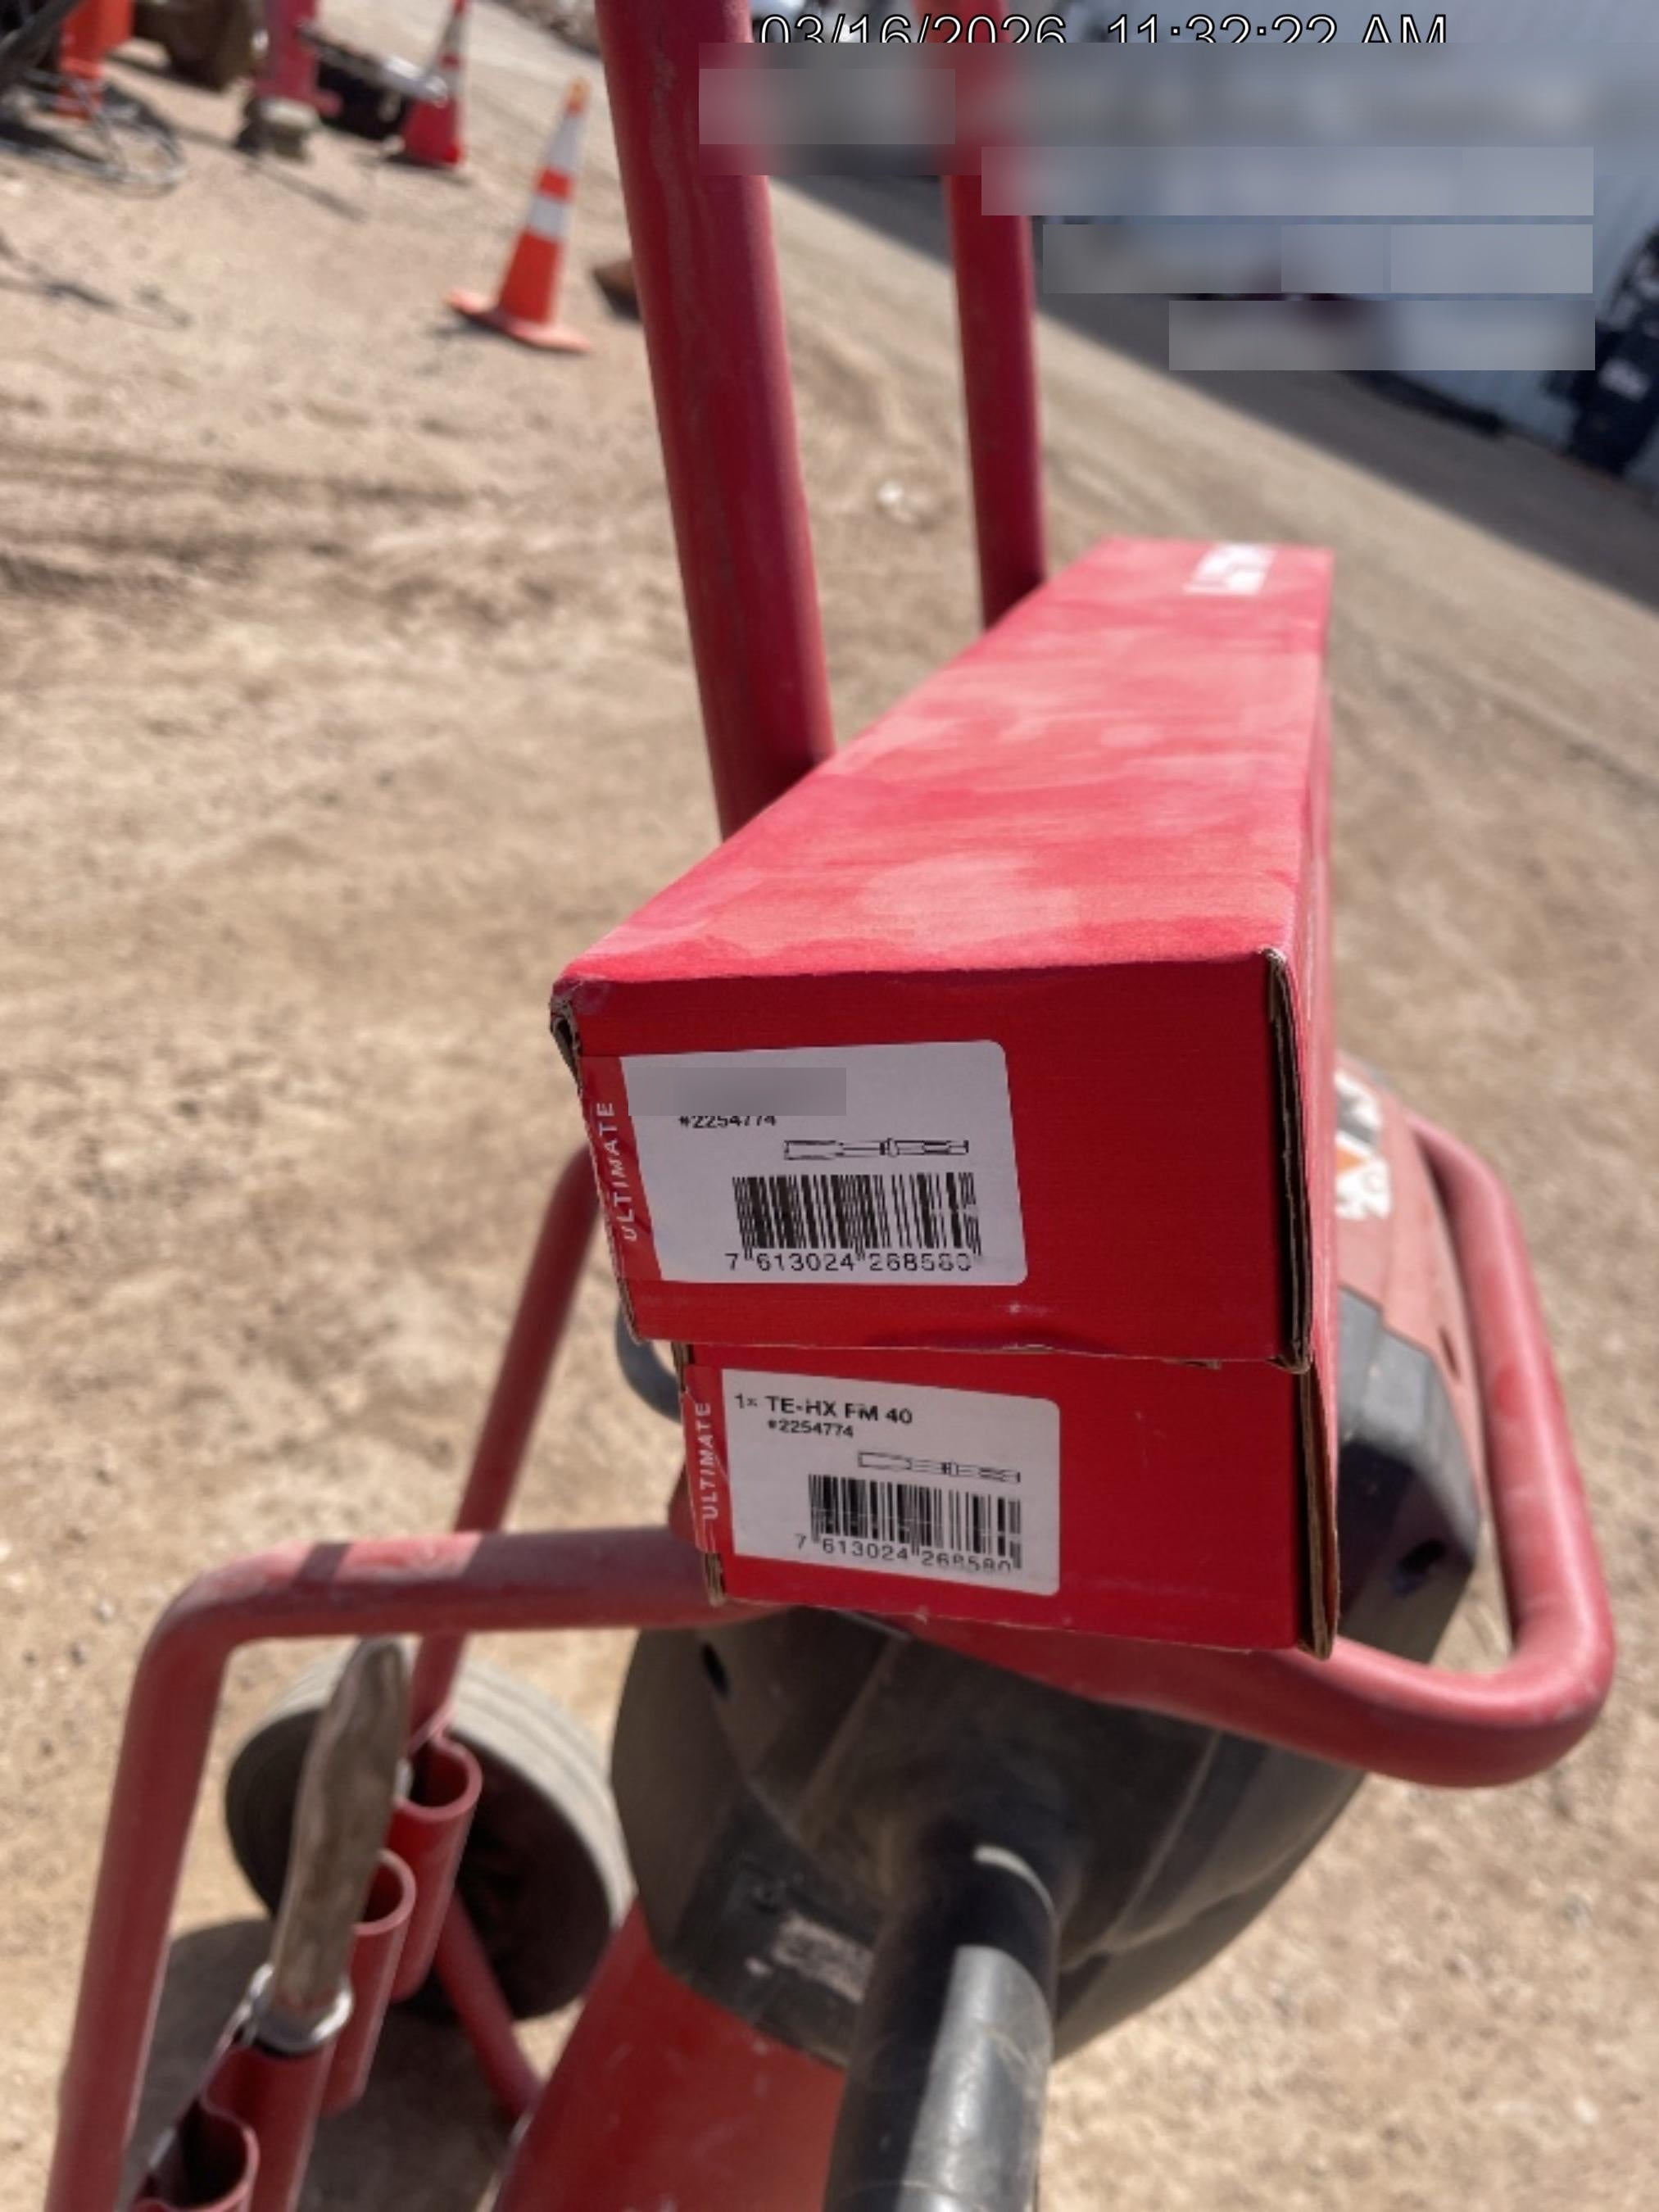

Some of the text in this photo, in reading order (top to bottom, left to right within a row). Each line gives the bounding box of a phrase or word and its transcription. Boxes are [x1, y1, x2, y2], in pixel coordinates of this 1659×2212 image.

[596, 1102, 637, 1241] ULTIMATE
[725, 1253, 739, 1271] 7
[756, 1253, 854, 1271] 613024
[765, 1395, 836, 1416] TE-HX
[845, 1402, 879, 1421] FM
[885, 1407, 913, 1425] 40
[767, 1419, 854, 1439] #2254774
[695, 1402, 719, 1521] ULTIMATE
[795, 1533, 807, 1550] 7
[822, 1538, 909, 1562] 613024
